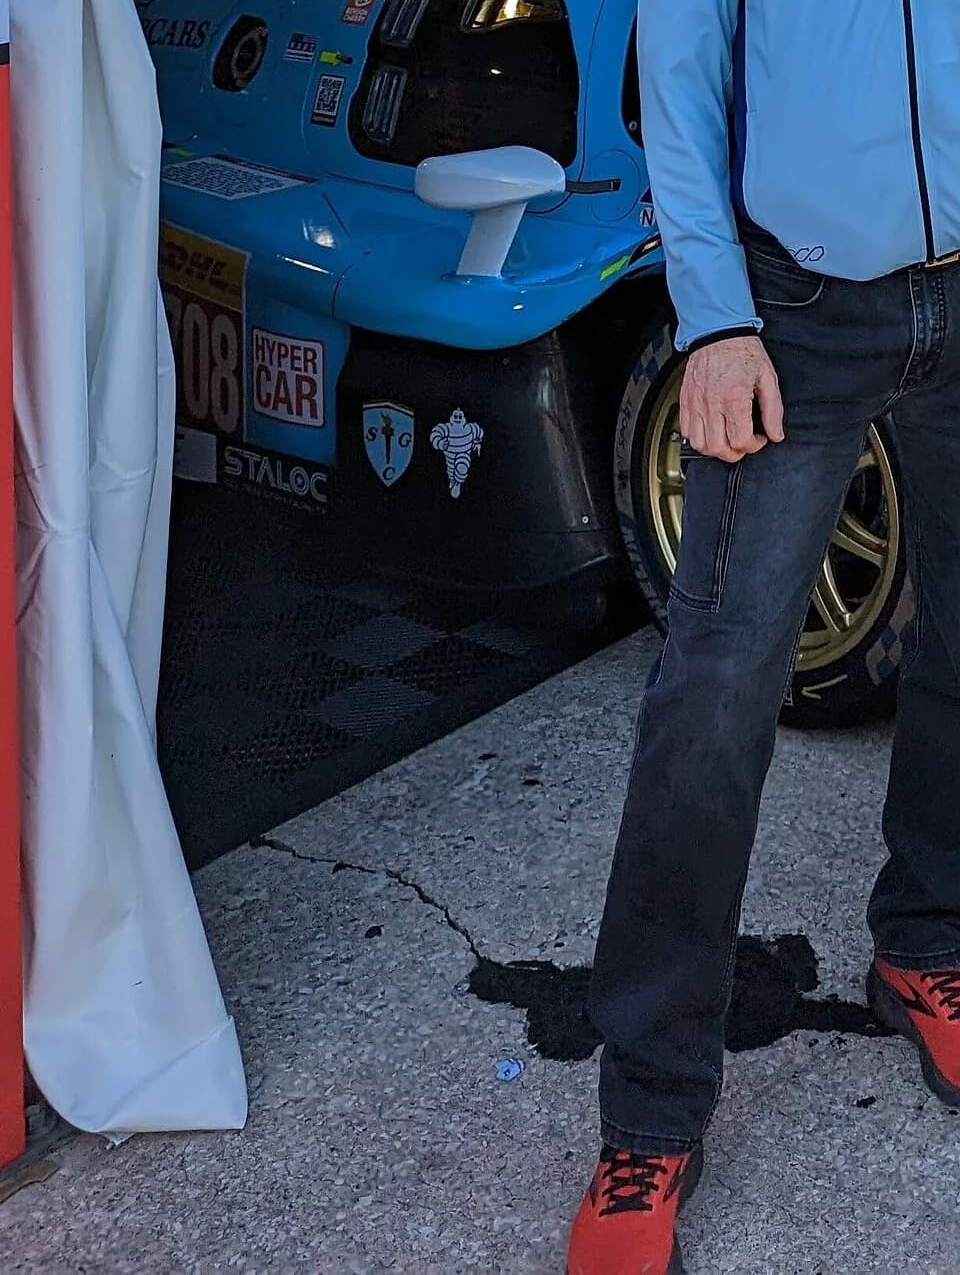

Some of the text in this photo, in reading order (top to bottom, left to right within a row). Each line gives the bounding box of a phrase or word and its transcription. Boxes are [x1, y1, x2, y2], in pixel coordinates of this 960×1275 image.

[255, 334, 318, 375] HYPER
[255, 363, 319, 421] CAR
[366, 427, 412, 447] S G
[223, 445, 329, 504] STALOC
[383, 466, 396, 481] C
